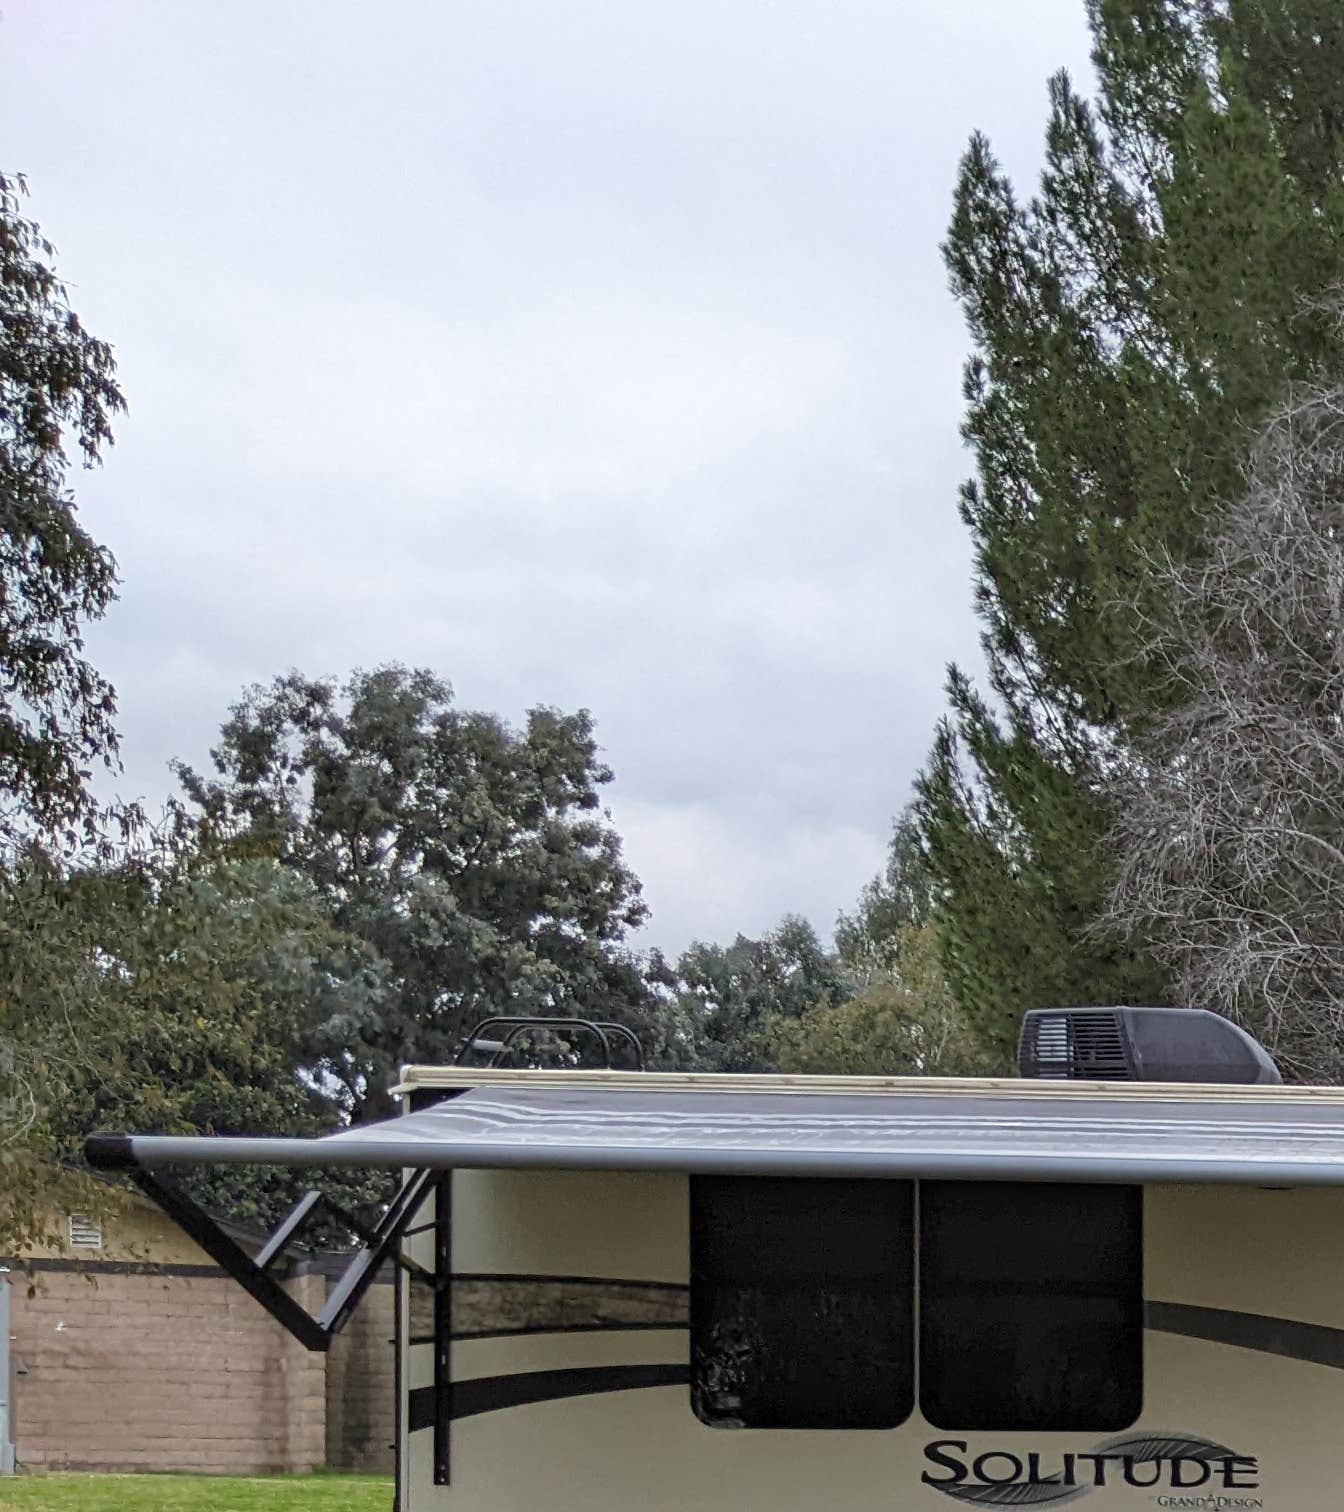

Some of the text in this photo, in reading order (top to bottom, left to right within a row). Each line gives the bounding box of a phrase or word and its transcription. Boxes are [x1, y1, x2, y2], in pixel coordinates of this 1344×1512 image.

[921, 1440, 1259, 1489] SOLITUDE
[1157, 1495, 1205, 1507] GRAND
[1216, 1496, 1263, 1508] DESIGN
